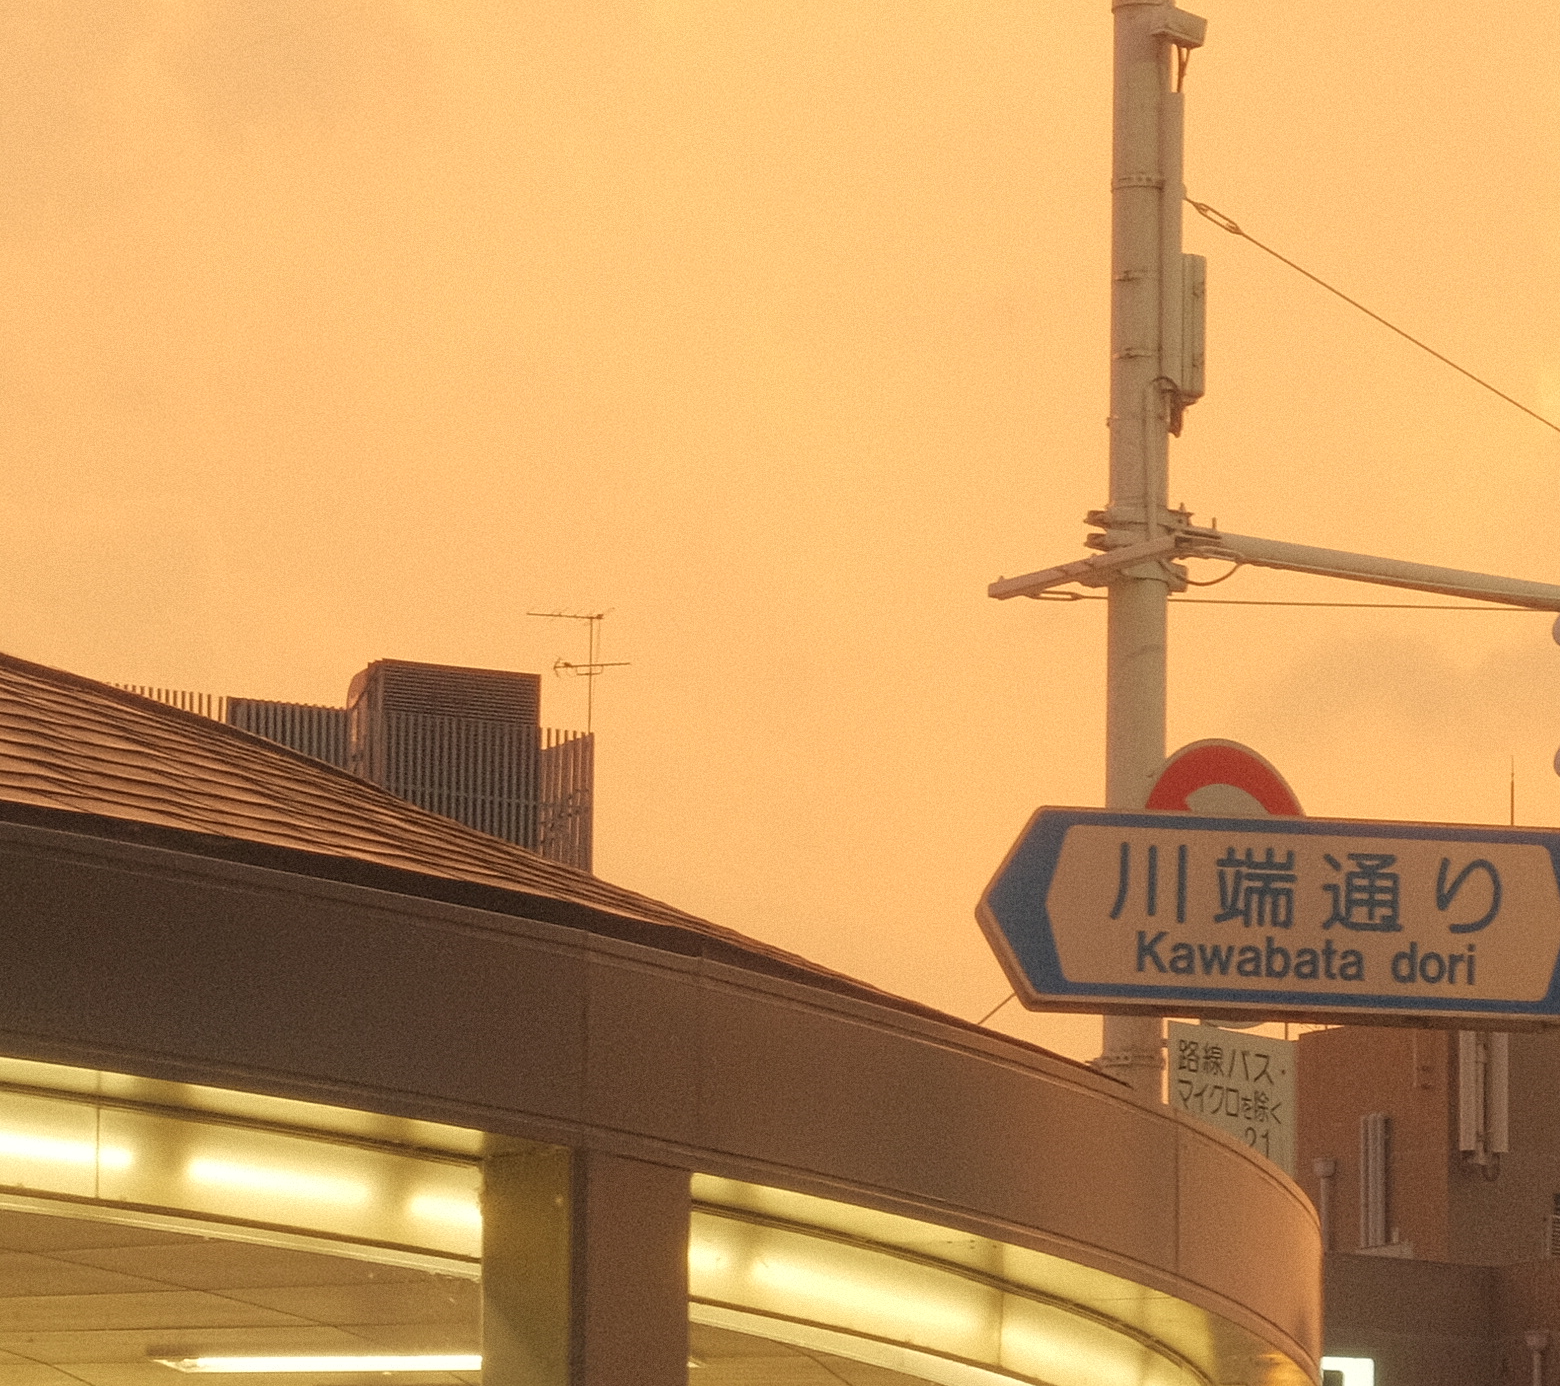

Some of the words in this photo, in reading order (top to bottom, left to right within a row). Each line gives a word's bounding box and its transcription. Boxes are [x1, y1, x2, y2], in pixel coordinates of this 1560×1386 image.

[1109, 841, 1502, 934] 川端通り
[1135, 929, 1365, 982] Kawabata
[1390, 941, 1476, 985] dori
[1177, 1078, 1282, 1125] マイクロを除く
